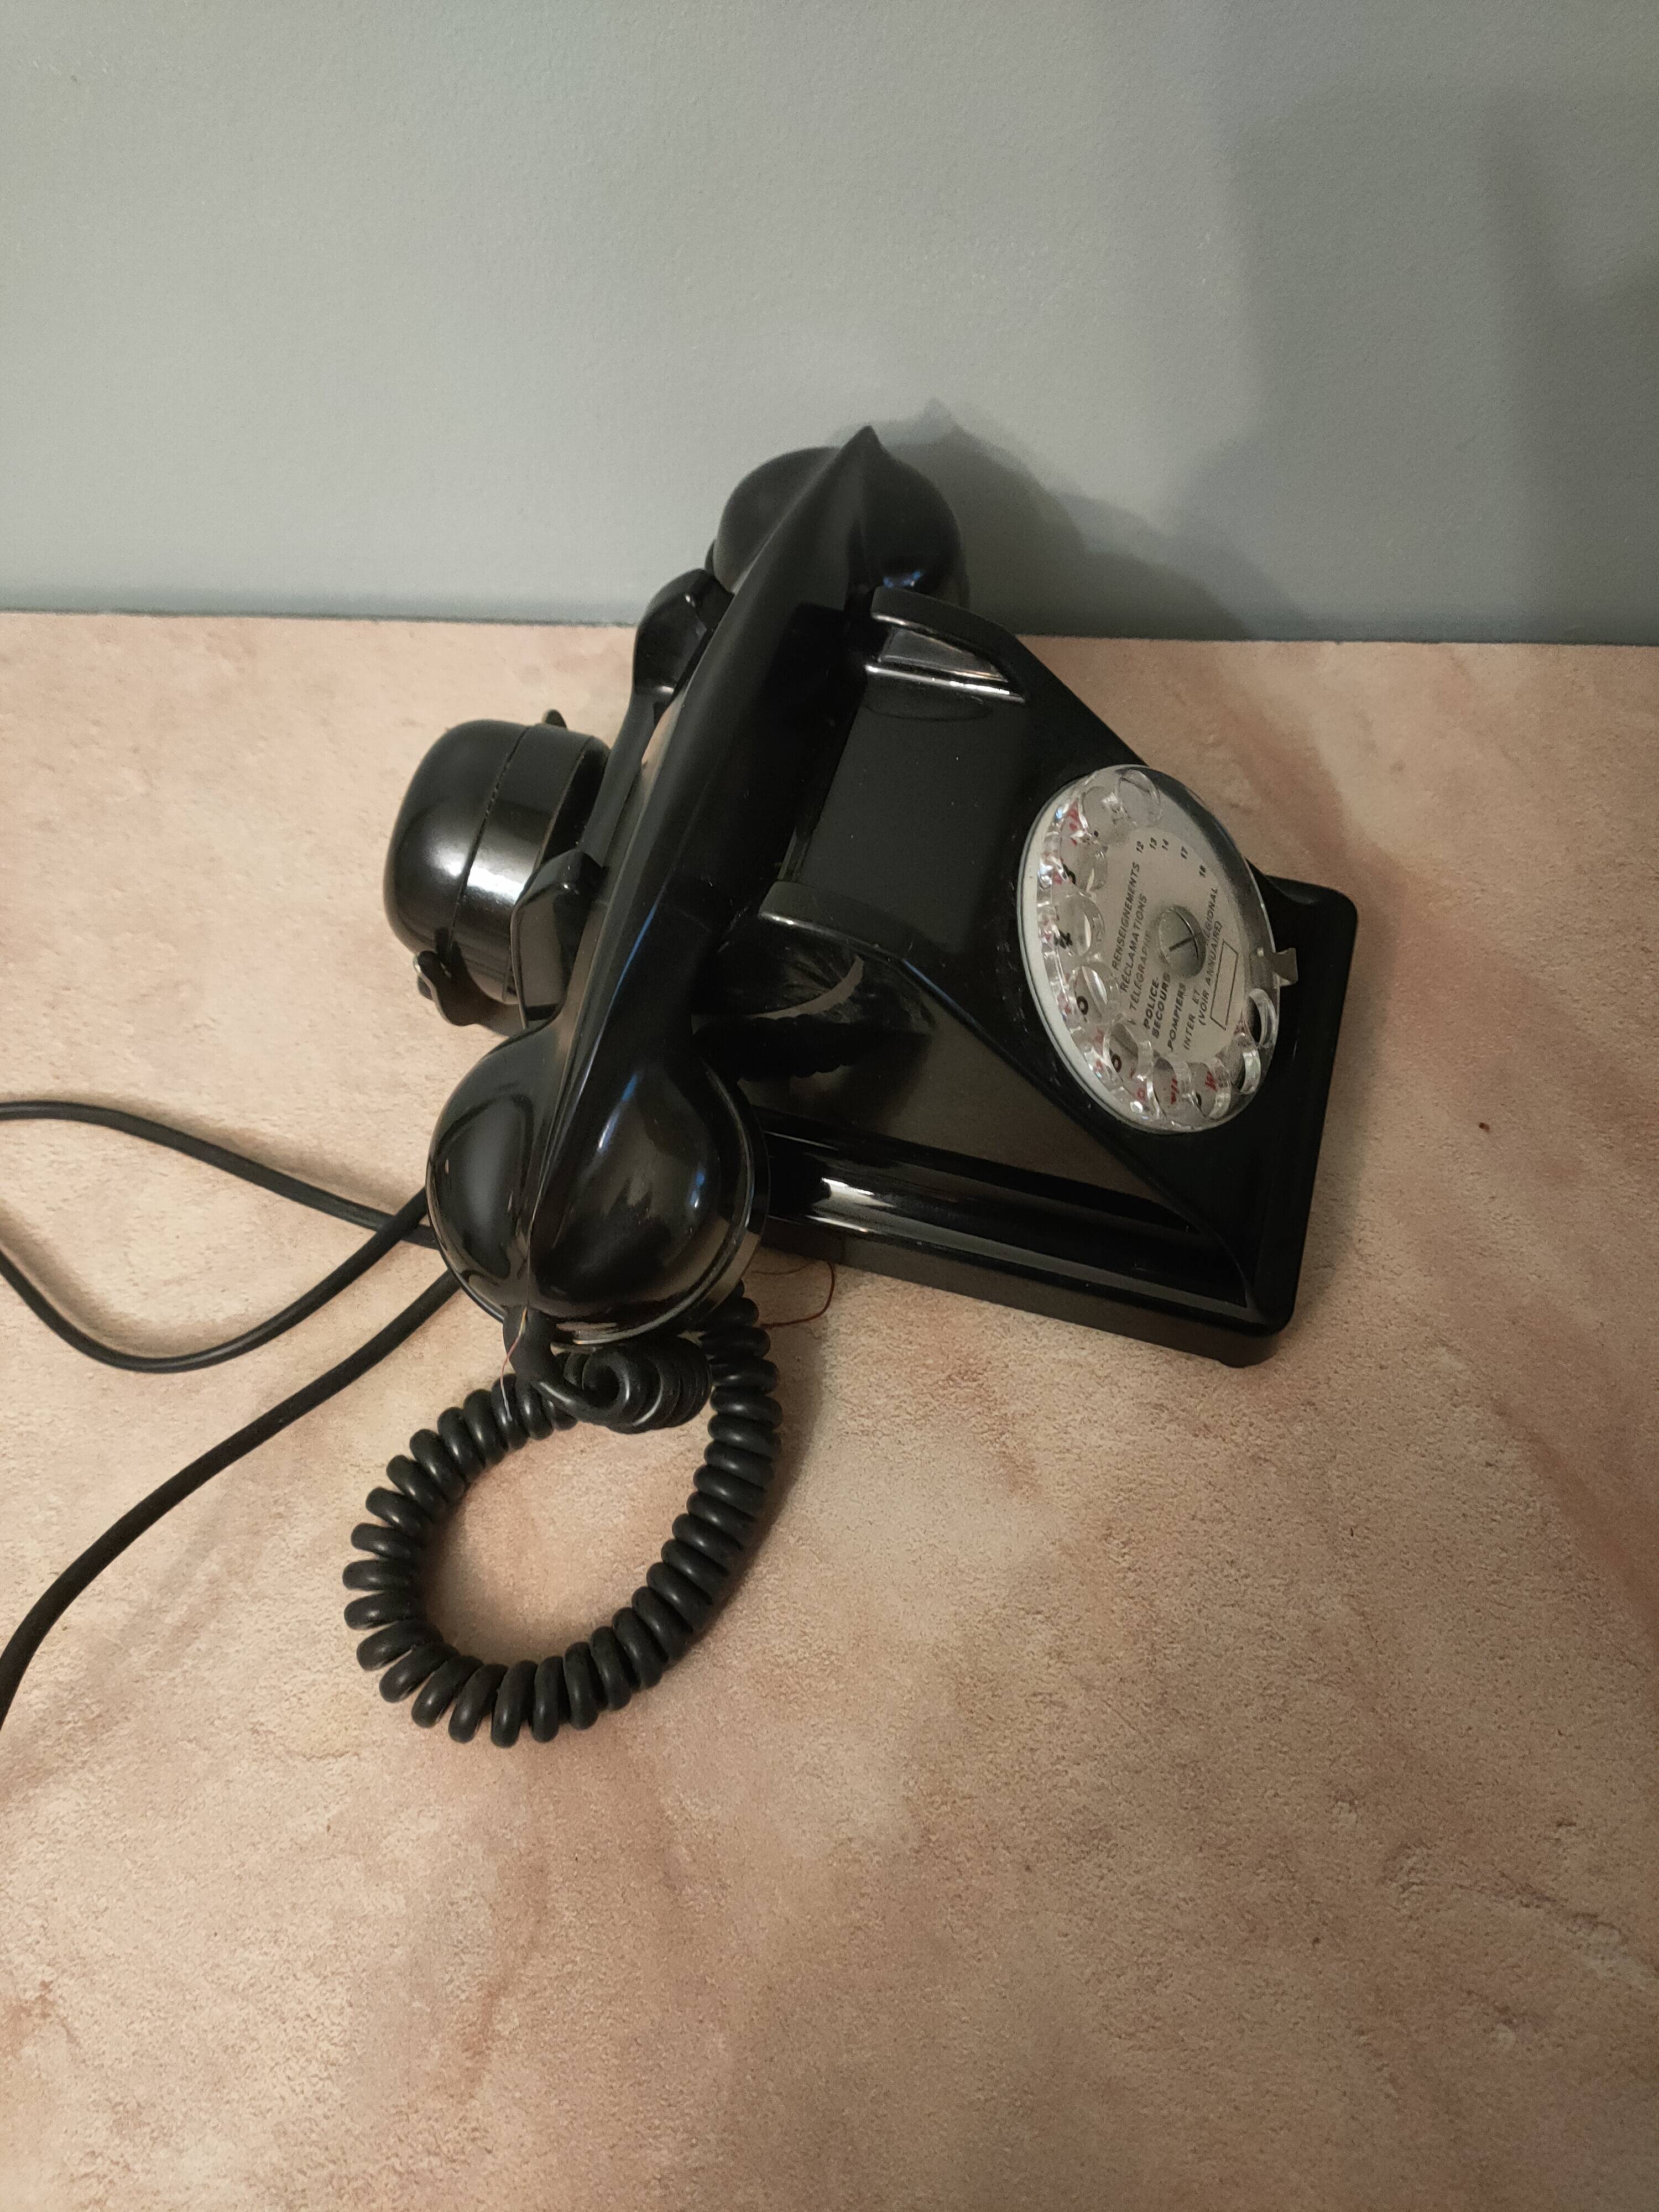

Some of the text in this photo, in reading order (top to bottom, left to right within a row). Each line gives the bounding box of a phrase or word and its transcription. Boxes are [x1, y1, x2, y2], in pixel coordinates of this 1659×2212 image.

[1112, 841, 1144, 971] RENSEIGNEMENTS 12
[1152, 846, 1188, 1039] SECOURS 17
[1183, 887, 1218, 1050] INTER ET ÉGIONAL
[1167, 983, 1186, 1052] POMPIERS
